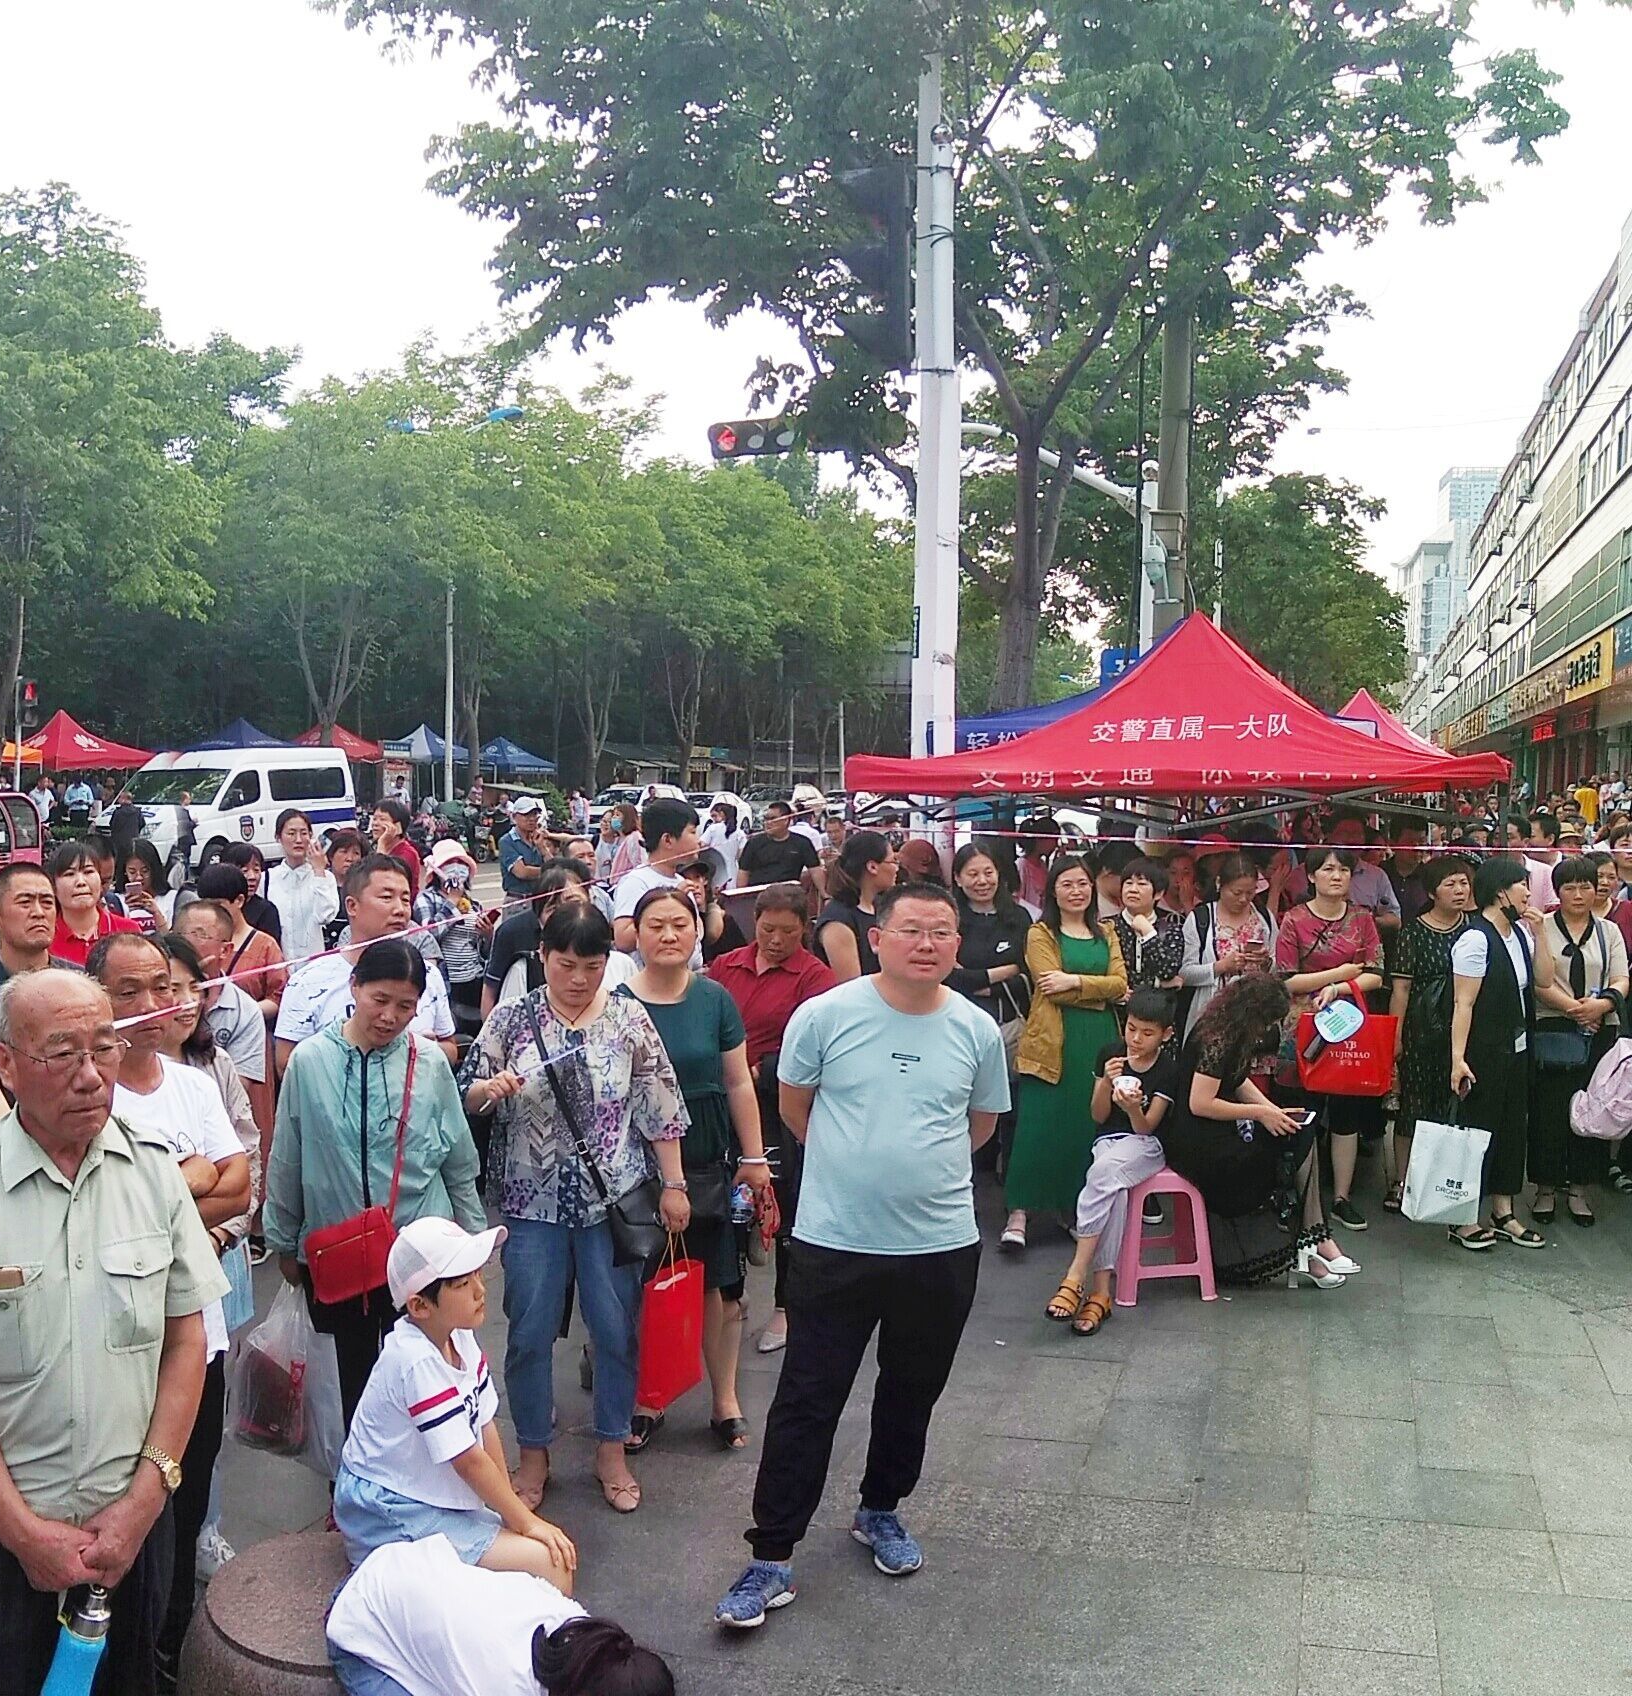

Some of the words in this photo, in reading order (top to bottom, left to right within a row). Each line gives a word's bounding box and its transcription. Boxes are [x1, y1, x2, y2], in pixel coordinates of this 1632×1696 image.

[1088, 713, 1293, 744] 交警直属一大队
[1329, 1051, 1371, 1060] YUJINBAO
